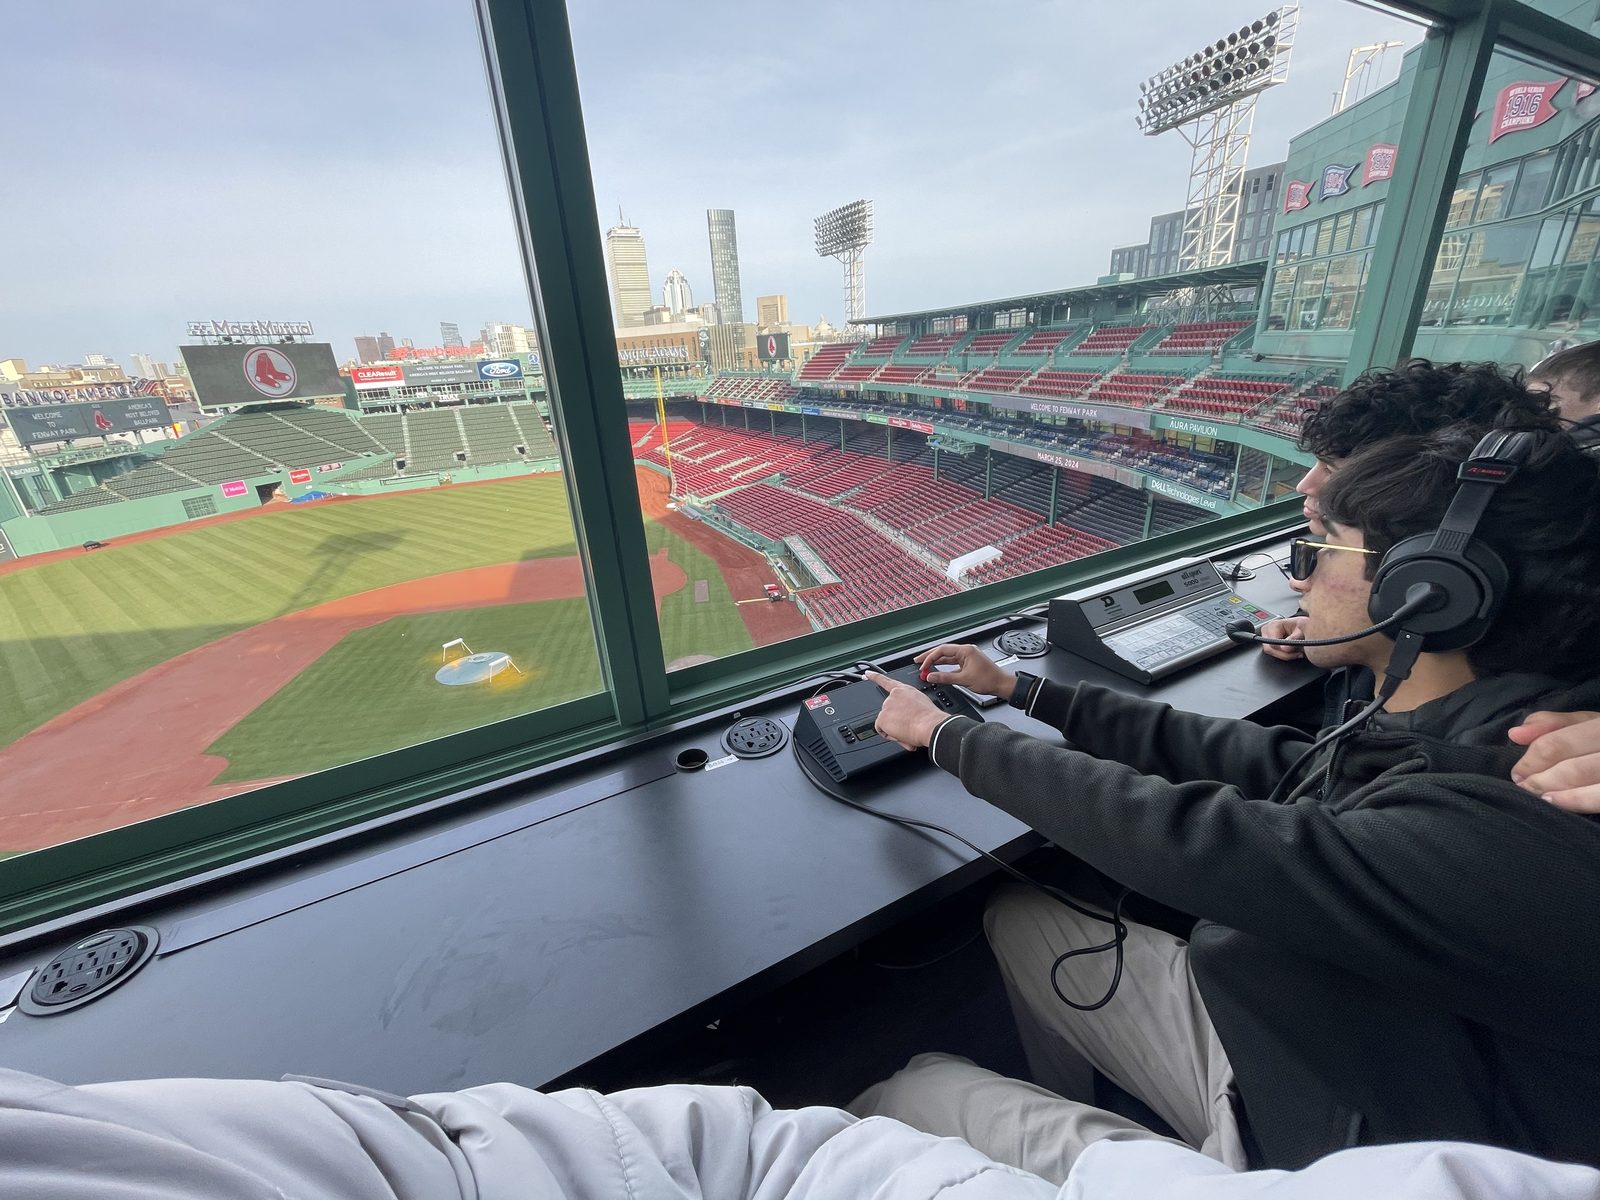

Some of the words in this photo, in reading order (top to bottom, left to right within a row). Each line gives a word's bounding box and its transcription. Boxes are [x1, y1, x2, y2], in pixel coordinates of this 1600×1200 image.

[1503, 93, 1543, 120] 1916
[357, 369, 397, 378] CLEAResult
[489, 364, 512, 375] Ford
[1, 391, 50, 405] BANK
[53, 389, 73, 402] OF
[32, 410, 63, 420] WELCOME
[1030, 403, 1051, 412] WELCOME
[1052, 405, 1059, 413] TO
[1060, 406, 1081, 415] FENWAY
[1082, 408, 1098, 417] PARK
[32, 429, 58, 440] FENWAY
[60, 427, 78, 436] PARK
[1189, 423, 1218, 436] PAVILION
[1037, 452, 1054, 462] MARCH
[1054, 456, 1063, 466] 25,
[1064, 459, 1079, 469] 2024
[1200, 496, 1217, 509] Level
